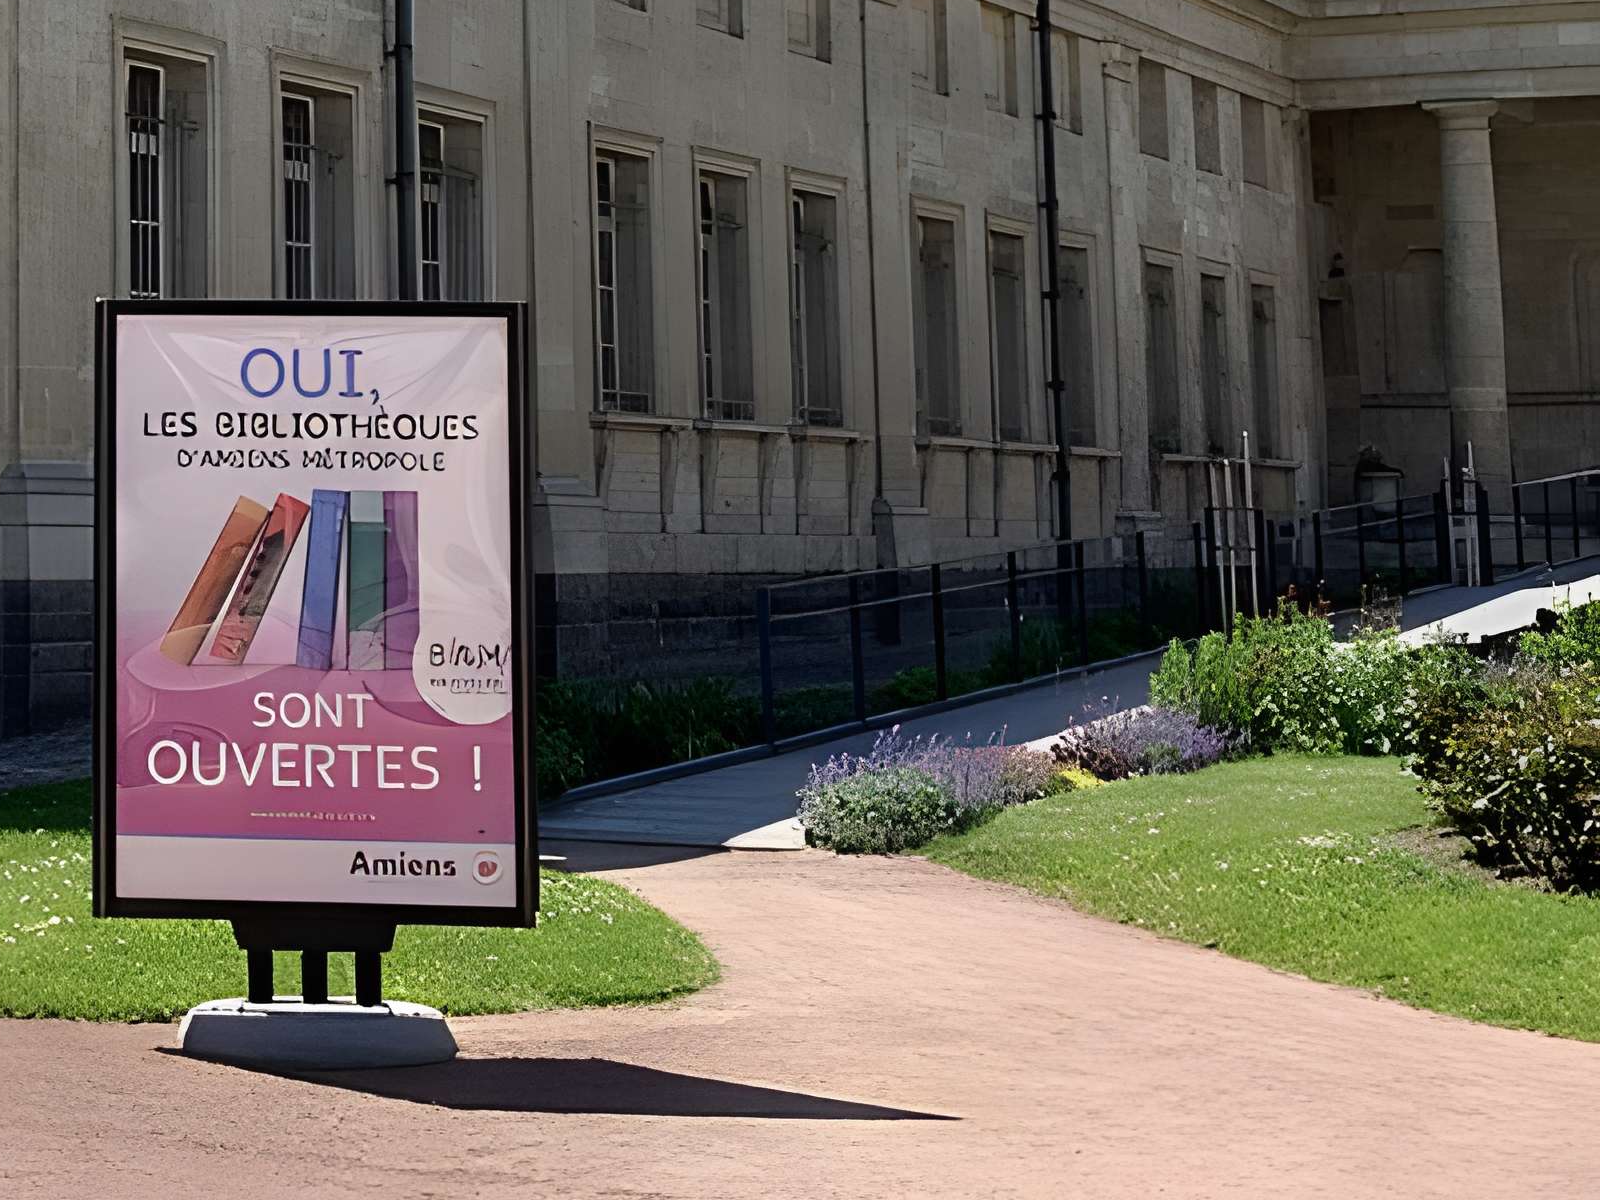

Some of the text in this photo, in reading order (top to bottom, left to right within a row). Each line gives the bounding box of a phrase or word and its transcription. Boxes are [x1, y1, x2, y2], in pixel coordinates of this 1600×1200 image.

[240, 348, 380, 405] OUI,
[143, 404, 480, 440] LES BIBLIOTHÈQUES
[252, 691, 374, 729] SONT
[147, 739, 483, 792] OUVERTES !
[350, 850, 457, 877] Amiens
